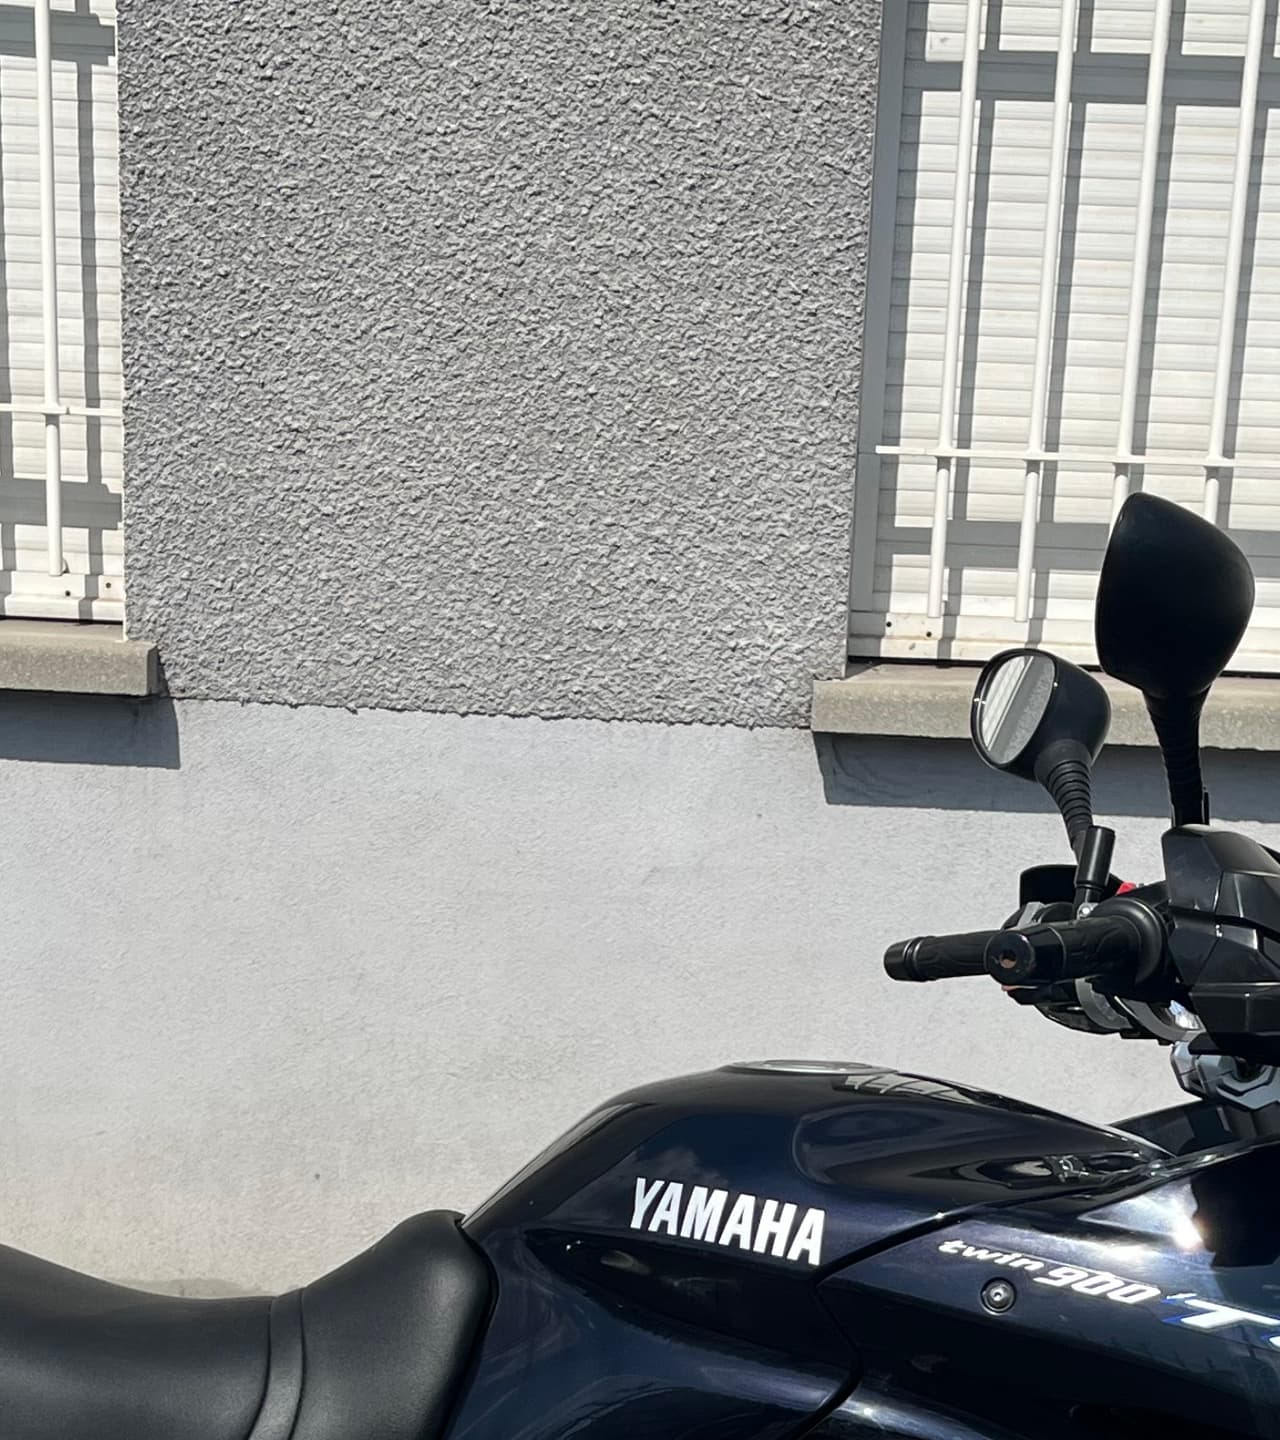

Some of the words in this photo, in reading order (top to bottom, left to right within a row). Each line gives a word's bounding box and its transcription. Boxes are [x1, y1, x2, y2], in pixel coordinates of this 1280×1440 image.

[630, 1177, 826, 1266] YAMAHA
[938, 1239, 1045, 1272] twin
[1033, 1266, 1162, 1305] 900
